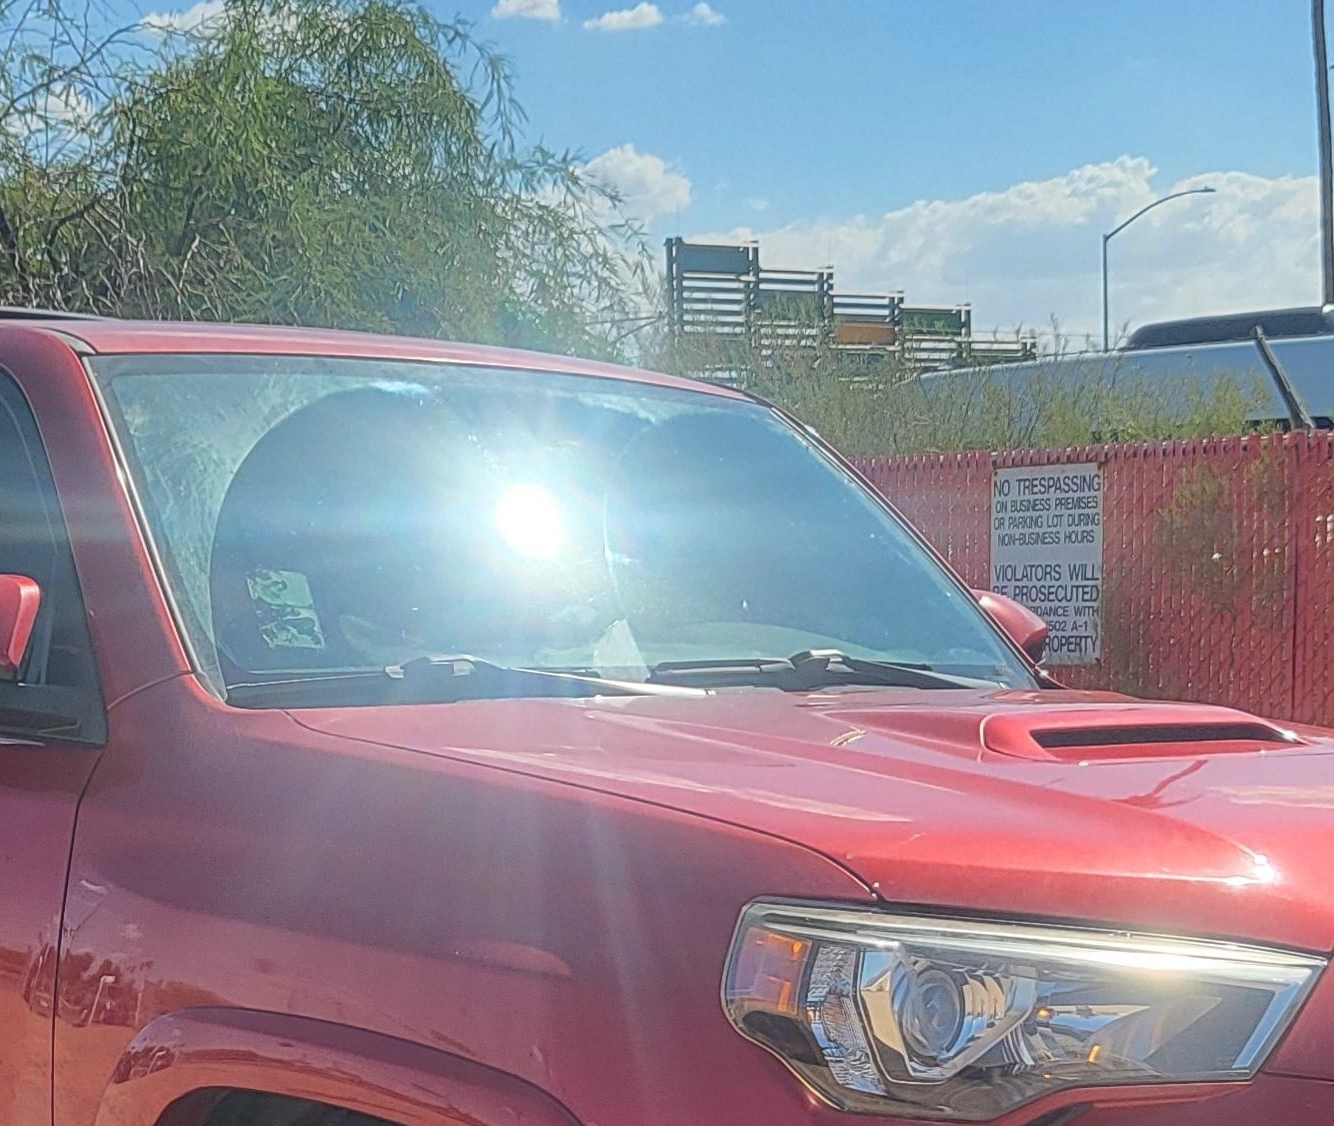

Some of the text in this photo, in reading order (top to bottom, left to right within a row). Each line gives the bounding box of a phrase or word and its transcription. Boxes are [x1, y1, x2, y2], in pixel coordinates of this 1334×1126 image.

[994, 474, 1100, 497] NO TRESPASSING
[995, 495, 1098, 513] ON BUSINESS PREMISES
[994, 512, 1100, 530] OR PARKING LOT DURING
[998, 529, 1095, 547] NON-BUSINESS HOURS
[994, 563, 1100, 582] VIOLATORS WILL
[1013, 584, 1100, 602] PROSECUTED
[1073, 605, 1100, 617] WITH
[1071, 619, 1088, 632] A-1
[1043, 635, 1099, 654] ROPERTY
